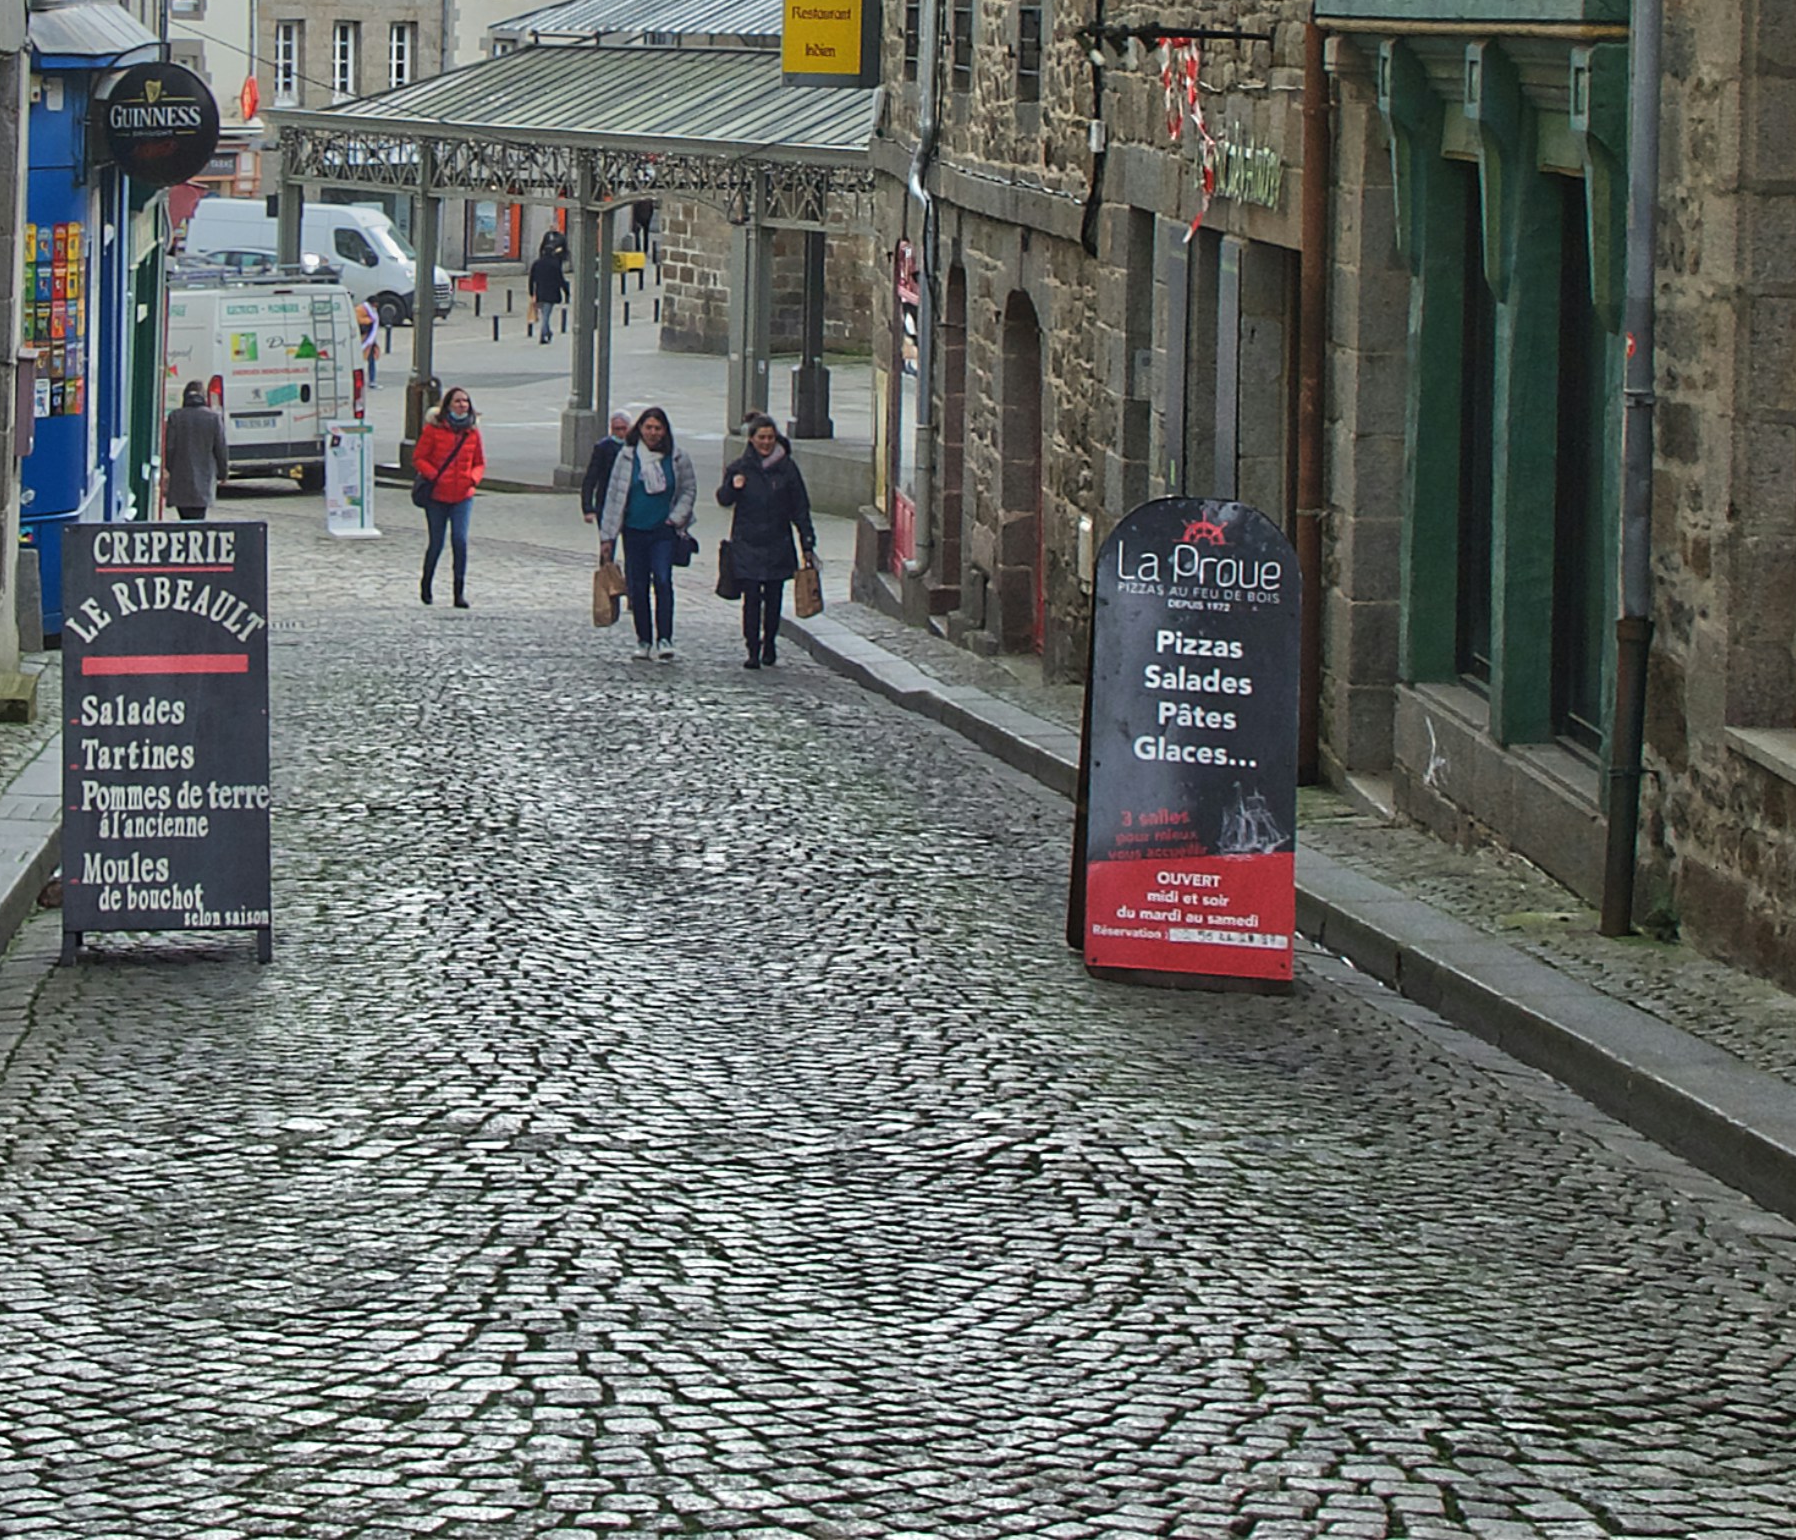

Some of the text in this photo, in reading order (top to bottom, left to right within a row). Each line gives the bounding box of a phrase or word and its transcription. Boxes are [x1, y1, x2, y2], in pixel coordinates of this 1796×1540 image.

[791, 6, 852, 20] Restaurant
[805, 42, 836, 57] Indien
[110, 105, 202, 129] GUINNESS
[93, 530, 235, 564] CREPERIE
[1118, 540, 1281, 590] La Proue
[1117, 582, 1280, 604] PIZZAS AU FEU DE BOIS
[1168, 600, 1203, 610] DEPUIS
[65, 577, 265, 644] LE RIBEAULT
[1156, 629, 1244, 659] Pizzas
[1144, 665, 1252, 695] Salades
[81, 695, 186, 726] Salades
[1158, 701, 1237, 730] Pâtes
[81, 739, 195, 770] Tartines
[1134, 735, 1257, 768] Glaces...
[81, 780, 270, 810] Pommes de terre
[1121, 808, 1189, 827] 3 salles
[1116, 831, 1149, 845] pour
[1108, 850, 1142, 860] vous
[82, 851, 169, 884] Moules
[1157, 871, 1221, 887] OUVERT
[99, 883, 204, 910] de bouchot
[1147, 890, 1229, 907] midi et soir
[184, 905, 269, 926] selon saison
[1116, 906, 1258, 927] du mardi au samedi
[1092, 924, 1161, 939] Réservation
